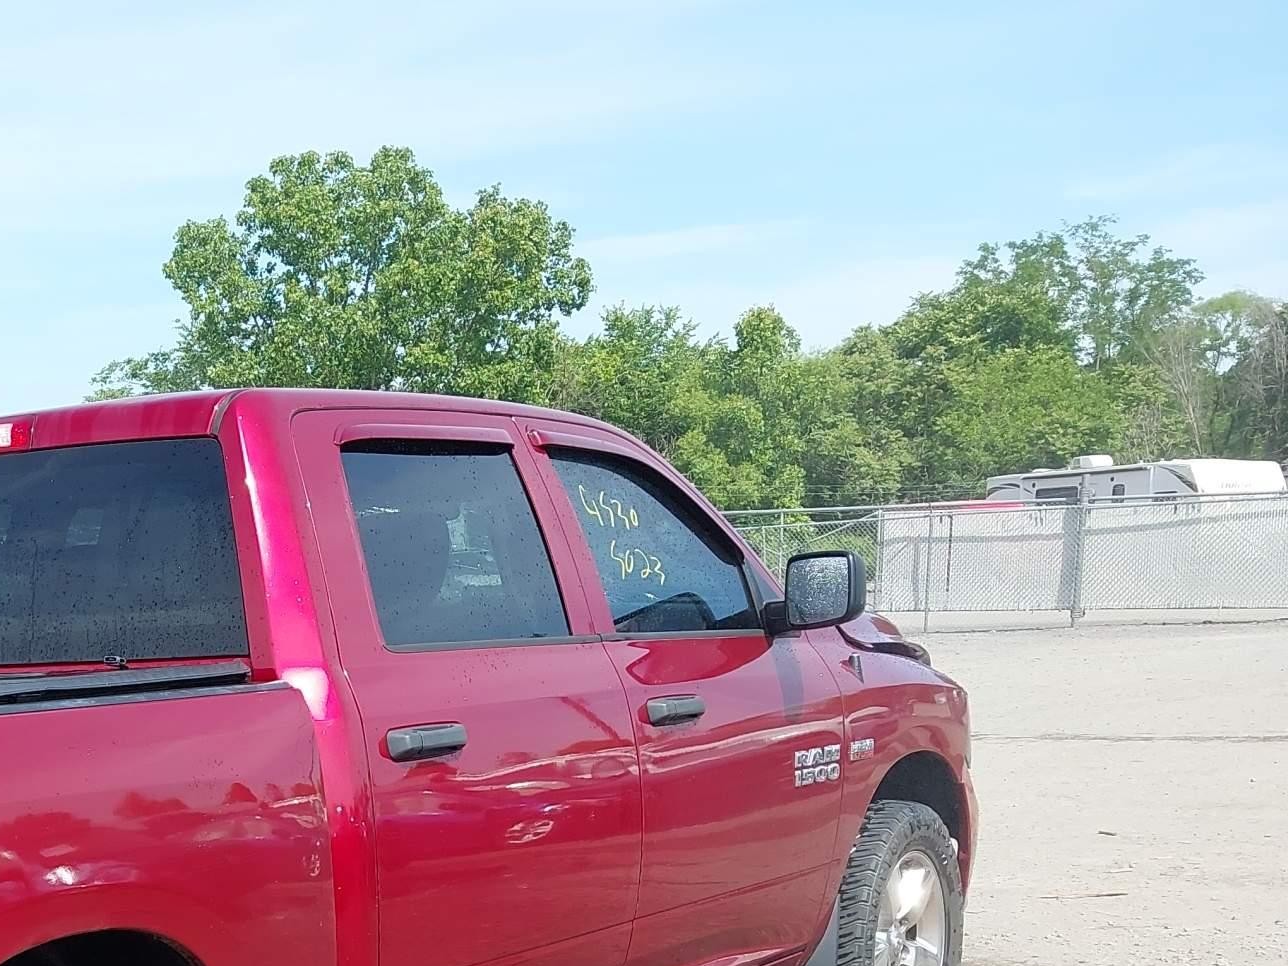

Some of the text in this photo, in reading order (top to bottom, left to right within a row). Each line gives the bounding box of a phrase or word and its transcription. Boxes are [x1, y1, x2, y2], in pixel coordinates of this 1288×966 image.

[578, 484, 639, 531] 4530
[611, 540, 666, 586] 5023
[794, 743, 841, 768] RAM
[794, 763, 841, 788] 1500
